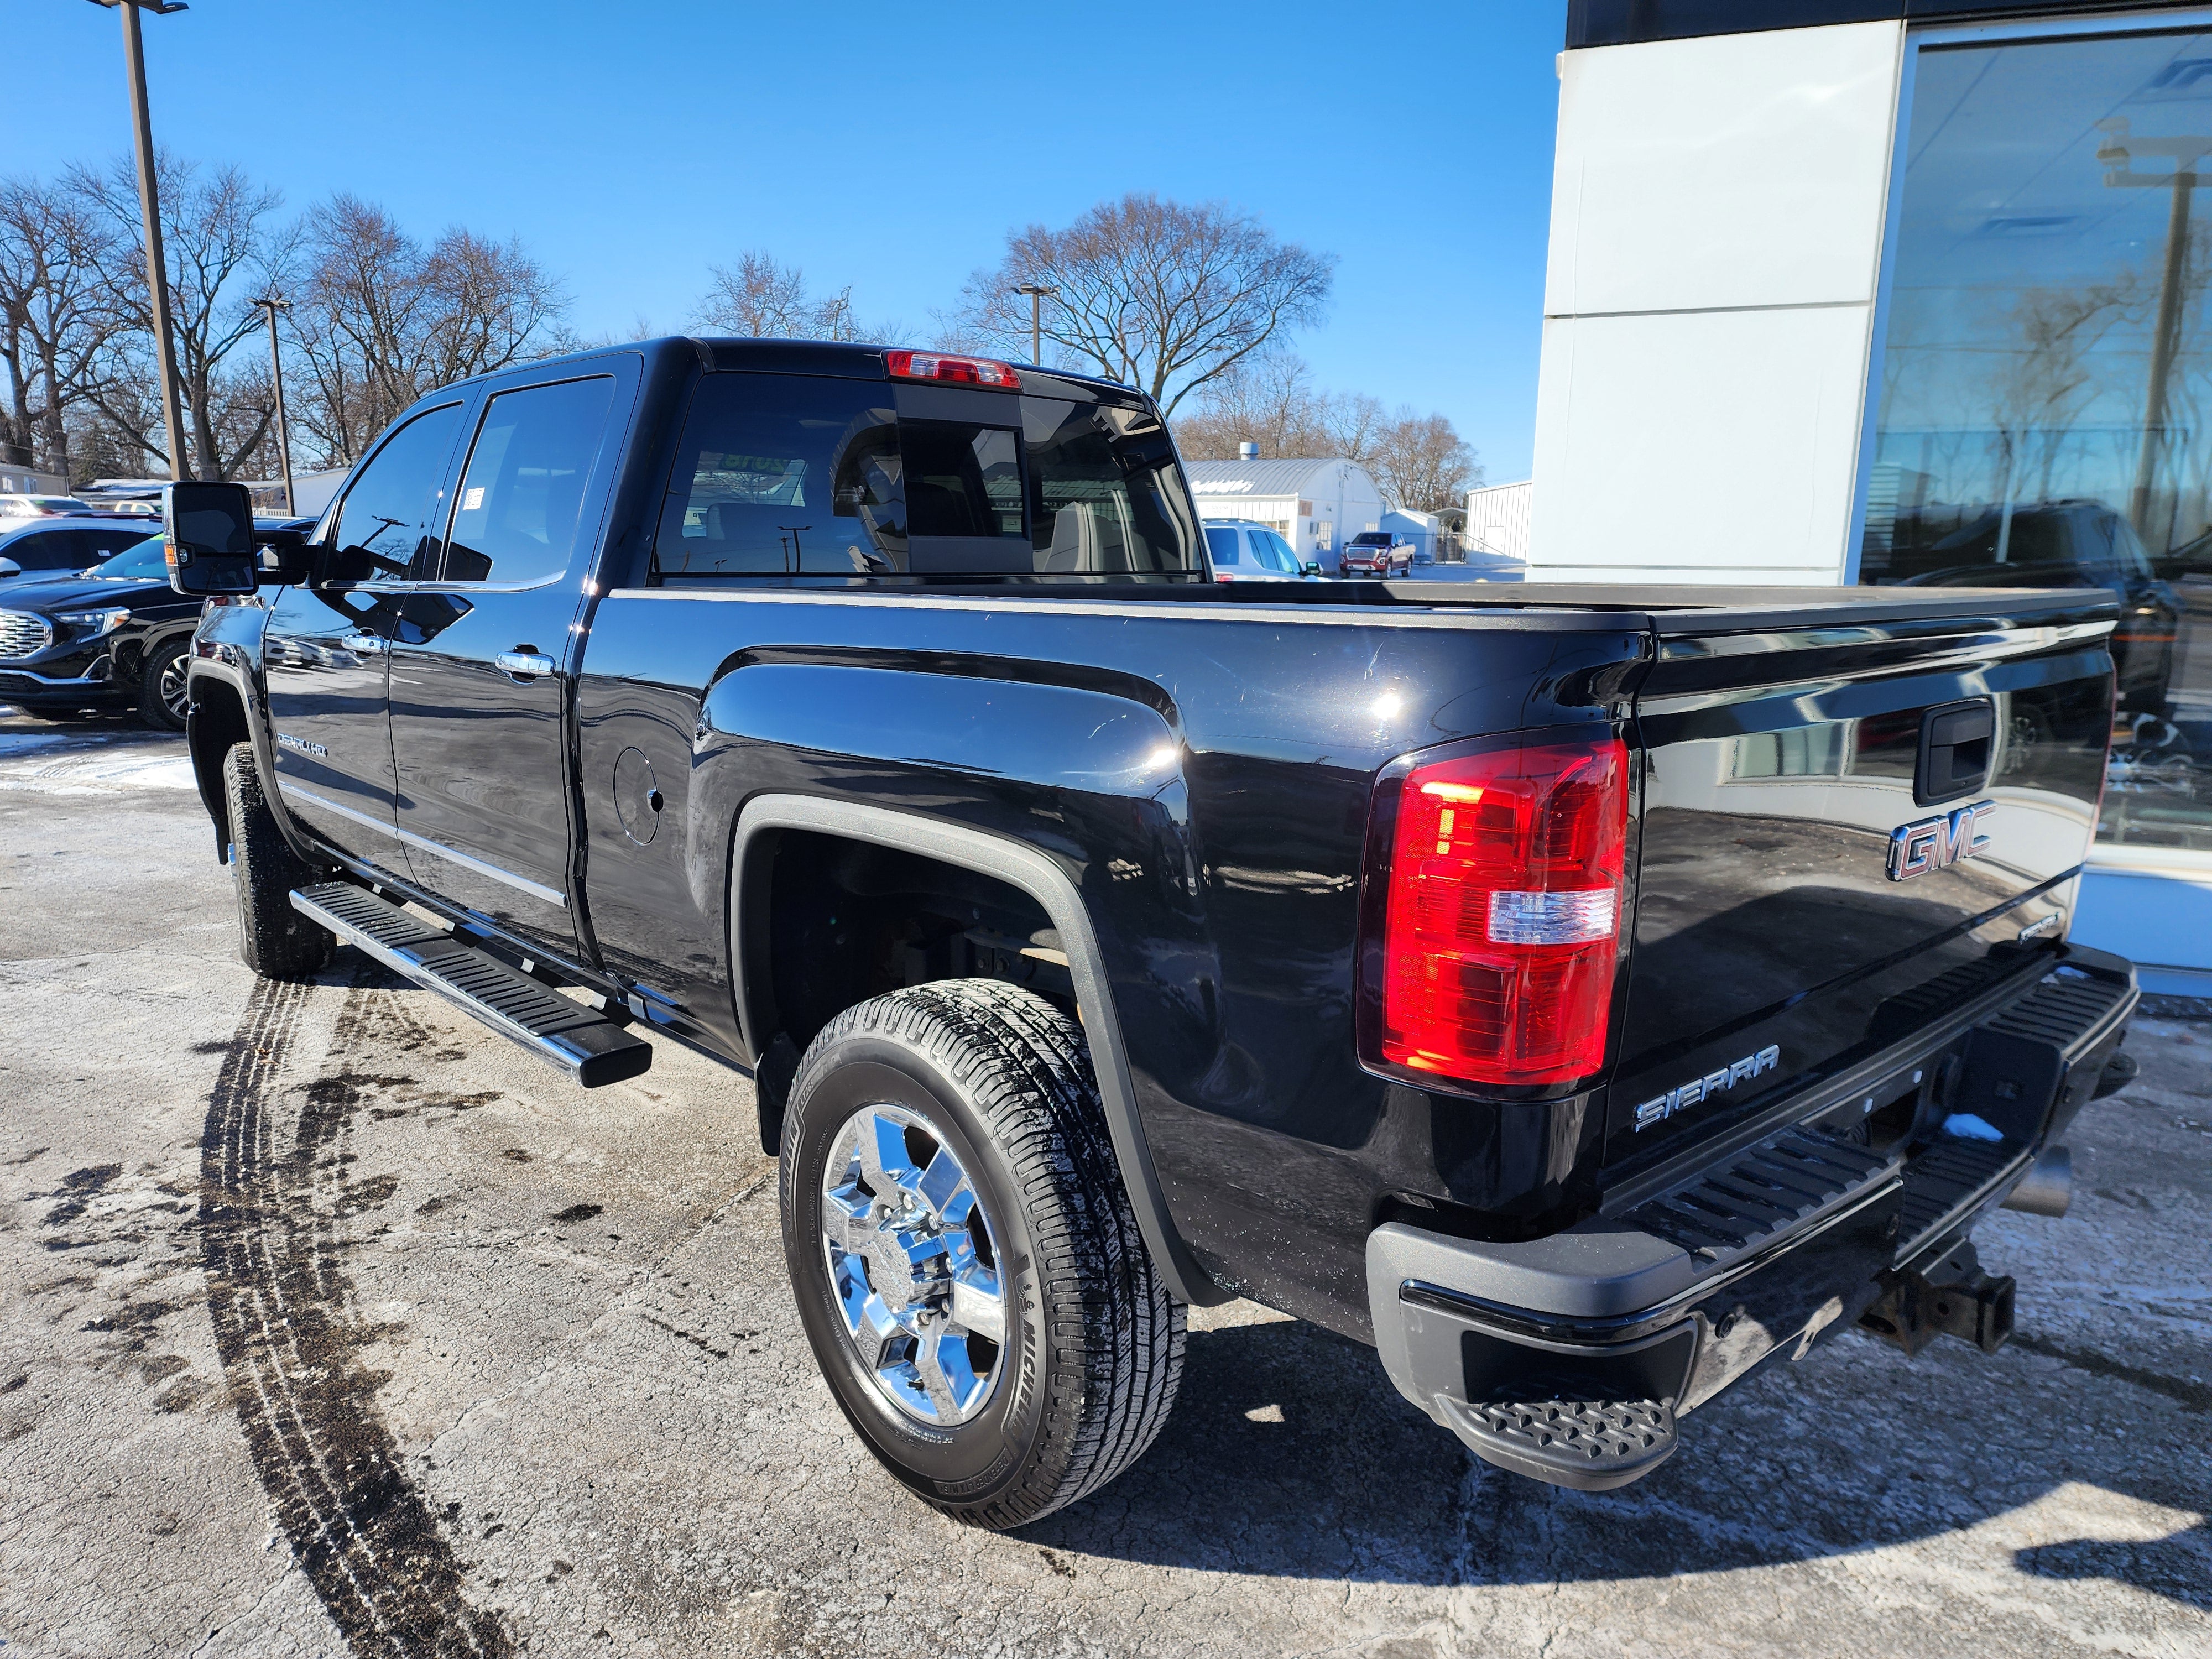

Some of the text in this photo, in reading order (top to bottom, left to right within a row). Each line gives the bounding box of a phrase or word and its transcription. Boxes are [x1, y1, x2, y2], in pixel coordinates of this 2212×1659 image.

[1885, 800, 1997, 882] GMC
[1634, 1044, 1780, 1133] SIERRA
[1011, 1319, 1036, 1438] MICHELIN
[977, 1455, 1010, 1490] DEFENDER
